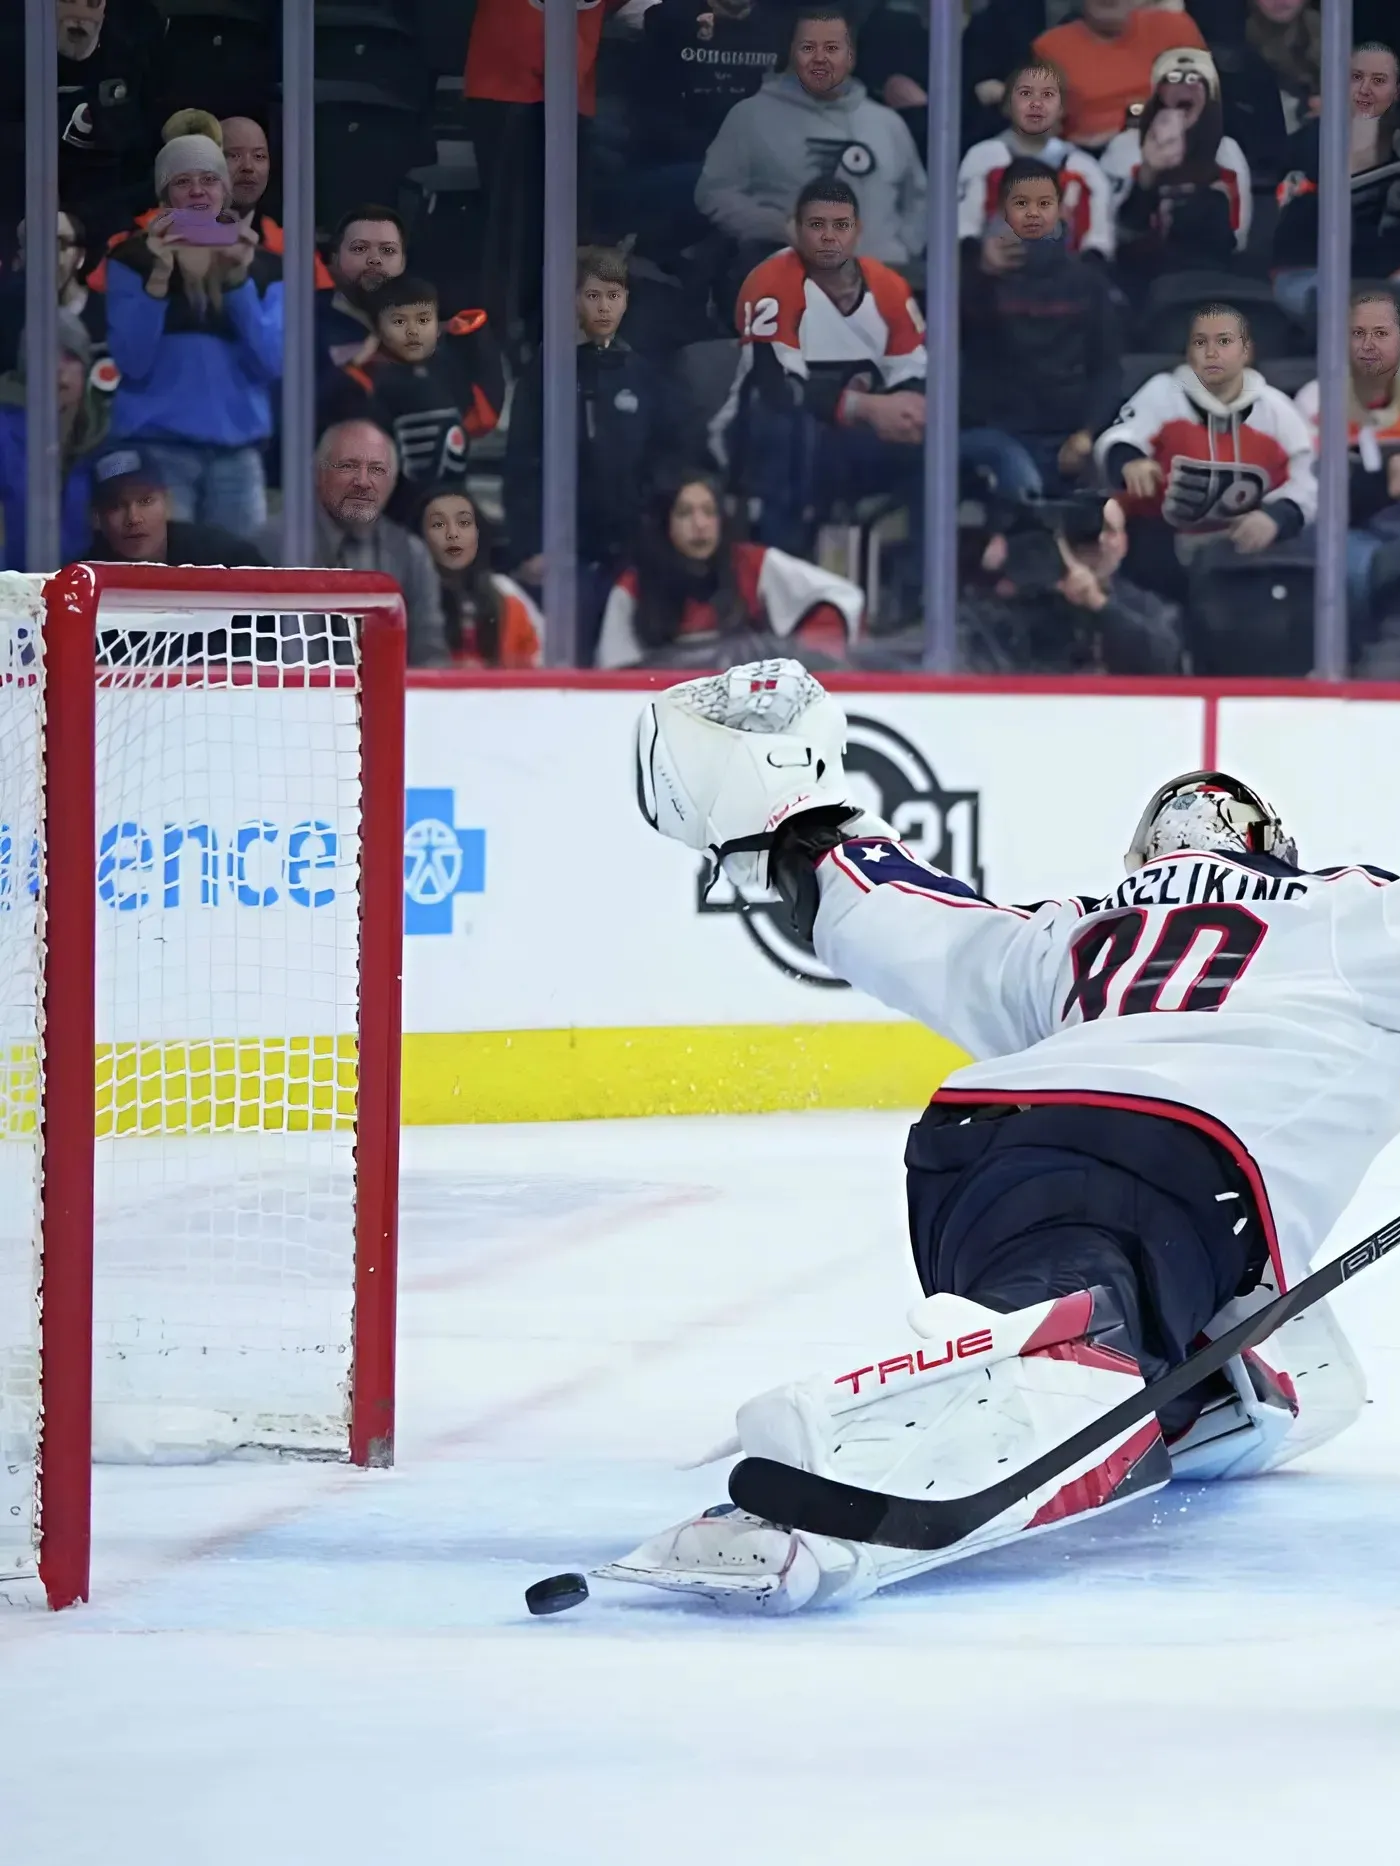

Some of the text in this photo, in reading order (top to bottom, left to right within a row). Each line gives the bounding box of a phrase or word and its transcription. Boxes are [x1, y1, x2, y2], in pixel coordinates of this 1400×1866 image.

[744, 297, 779, 337] 12
[28, 819, 337, 911] ence
[834, 1328, 993, 1394] TRUE
